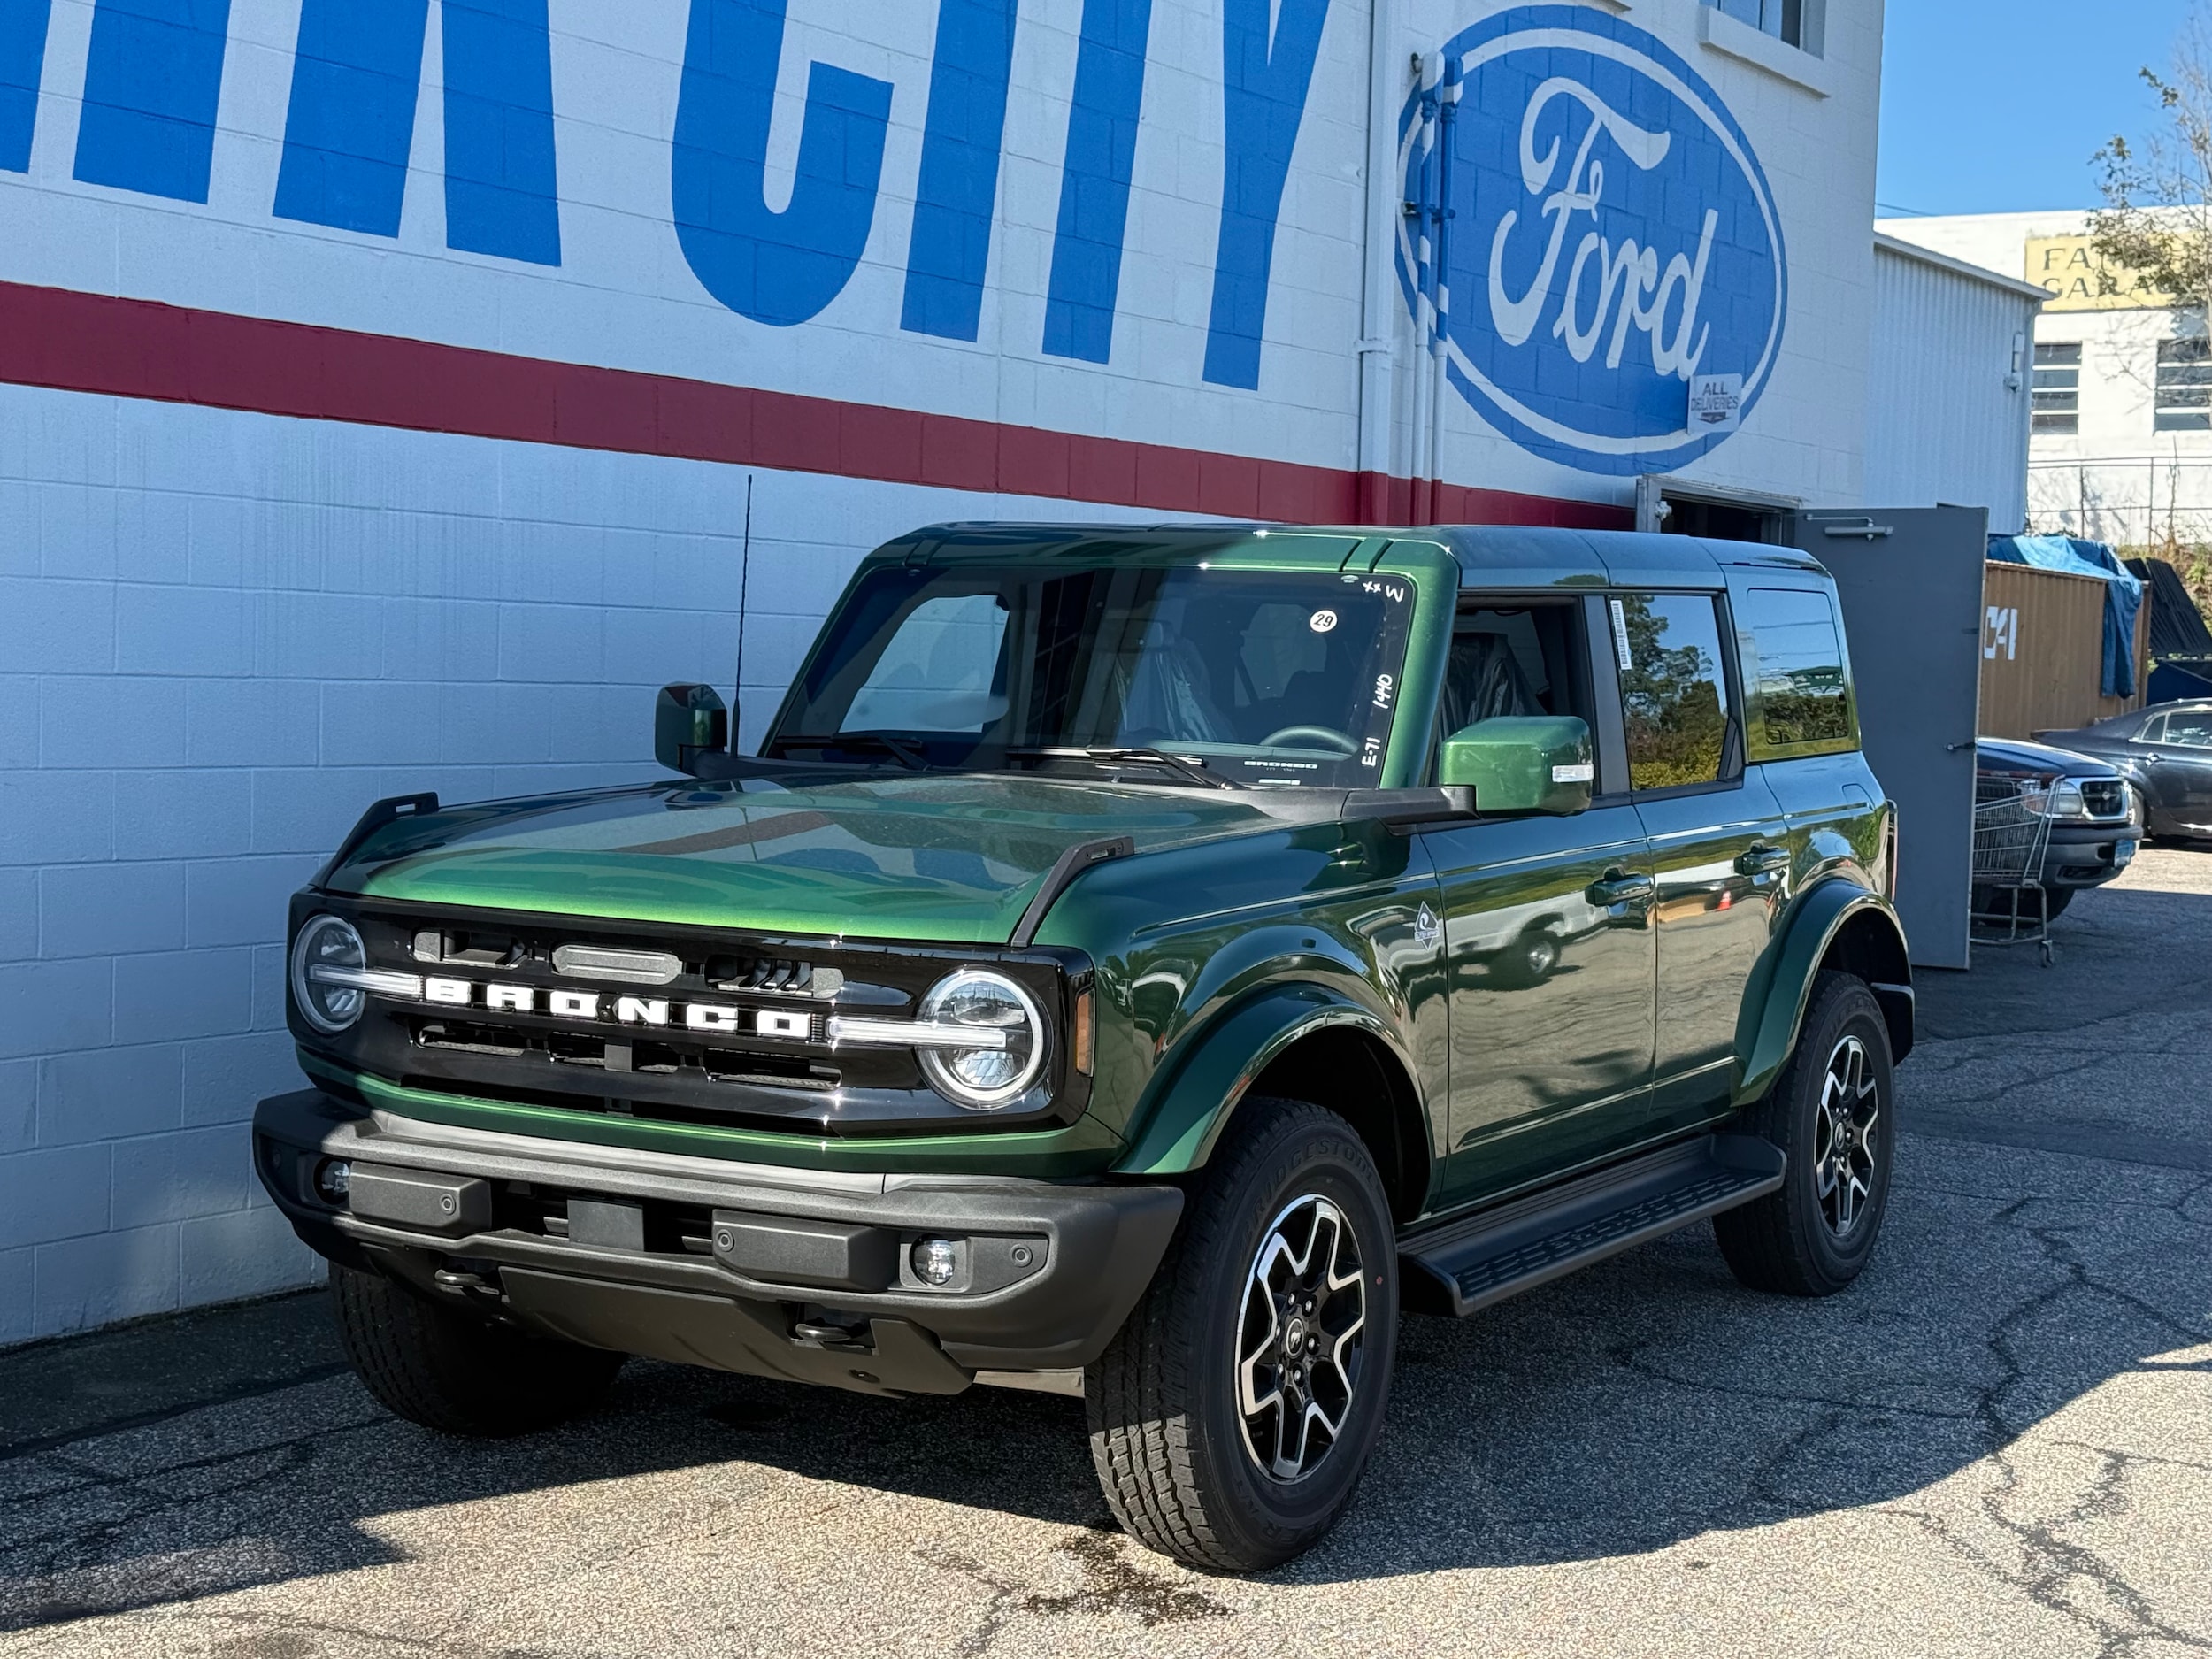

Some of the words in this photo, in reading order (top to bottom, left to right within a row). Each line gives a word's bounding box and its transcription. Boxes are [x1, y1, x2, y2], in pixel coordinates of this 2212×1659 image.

[1488, 76, 1719, 381] Ford
[2041, 276, 2180, 300] GARAG
[1702, 381, 1728, 396] ALL
[1691, 396, 1740, 411] DELIVERIES
[1314, 612, 1334, 629] 29
[1372, 673, 1393, 709] 1440
[425, 976, 812, 1039] BRONCO
